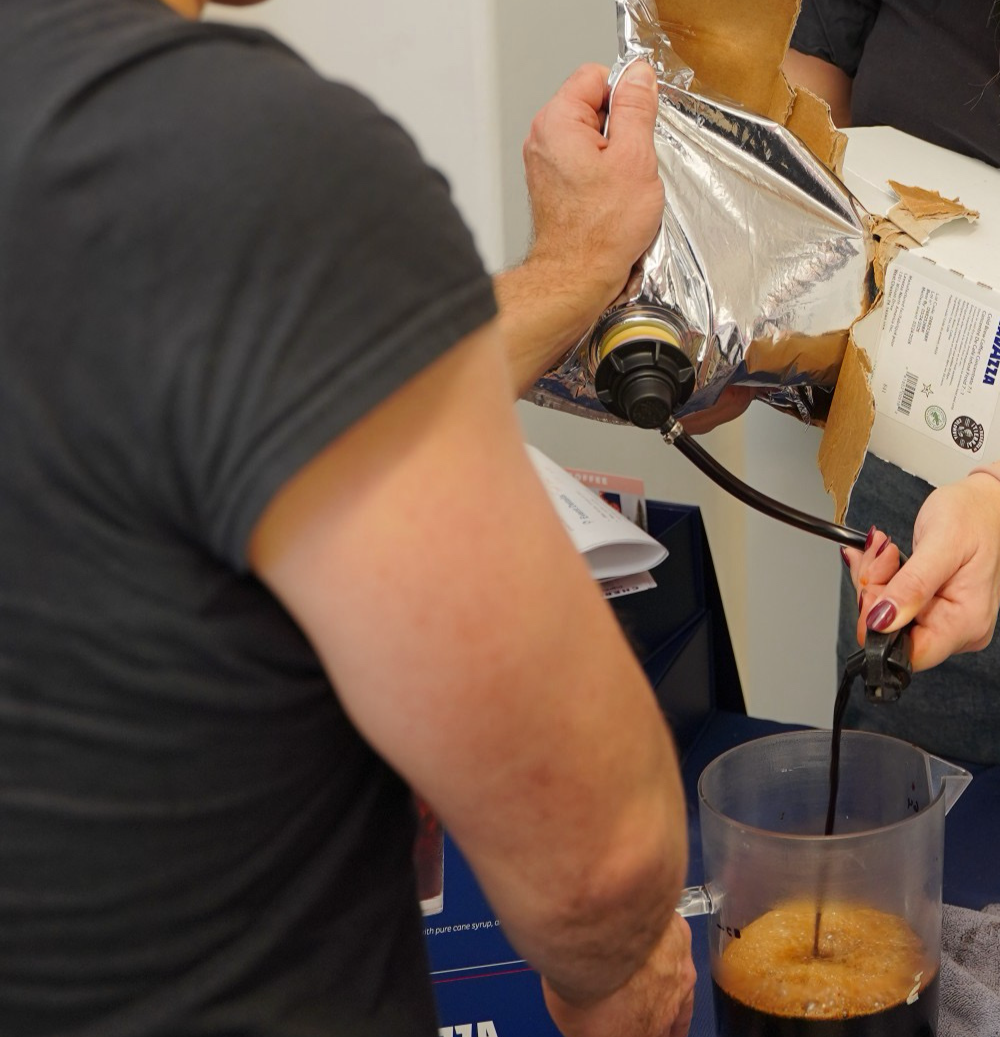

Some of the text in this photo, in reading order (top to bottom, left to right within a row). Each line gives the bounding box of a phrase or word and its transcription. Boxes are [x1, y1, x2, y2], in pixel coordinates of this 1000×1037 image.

[572, 472, 608, 486] OFFEE
[422, 925, 435, 936] ith
[435, 925, 452, 936] pure
[453, 922, 471, 932] cane
[471, 919, 494, 931] syrup,
